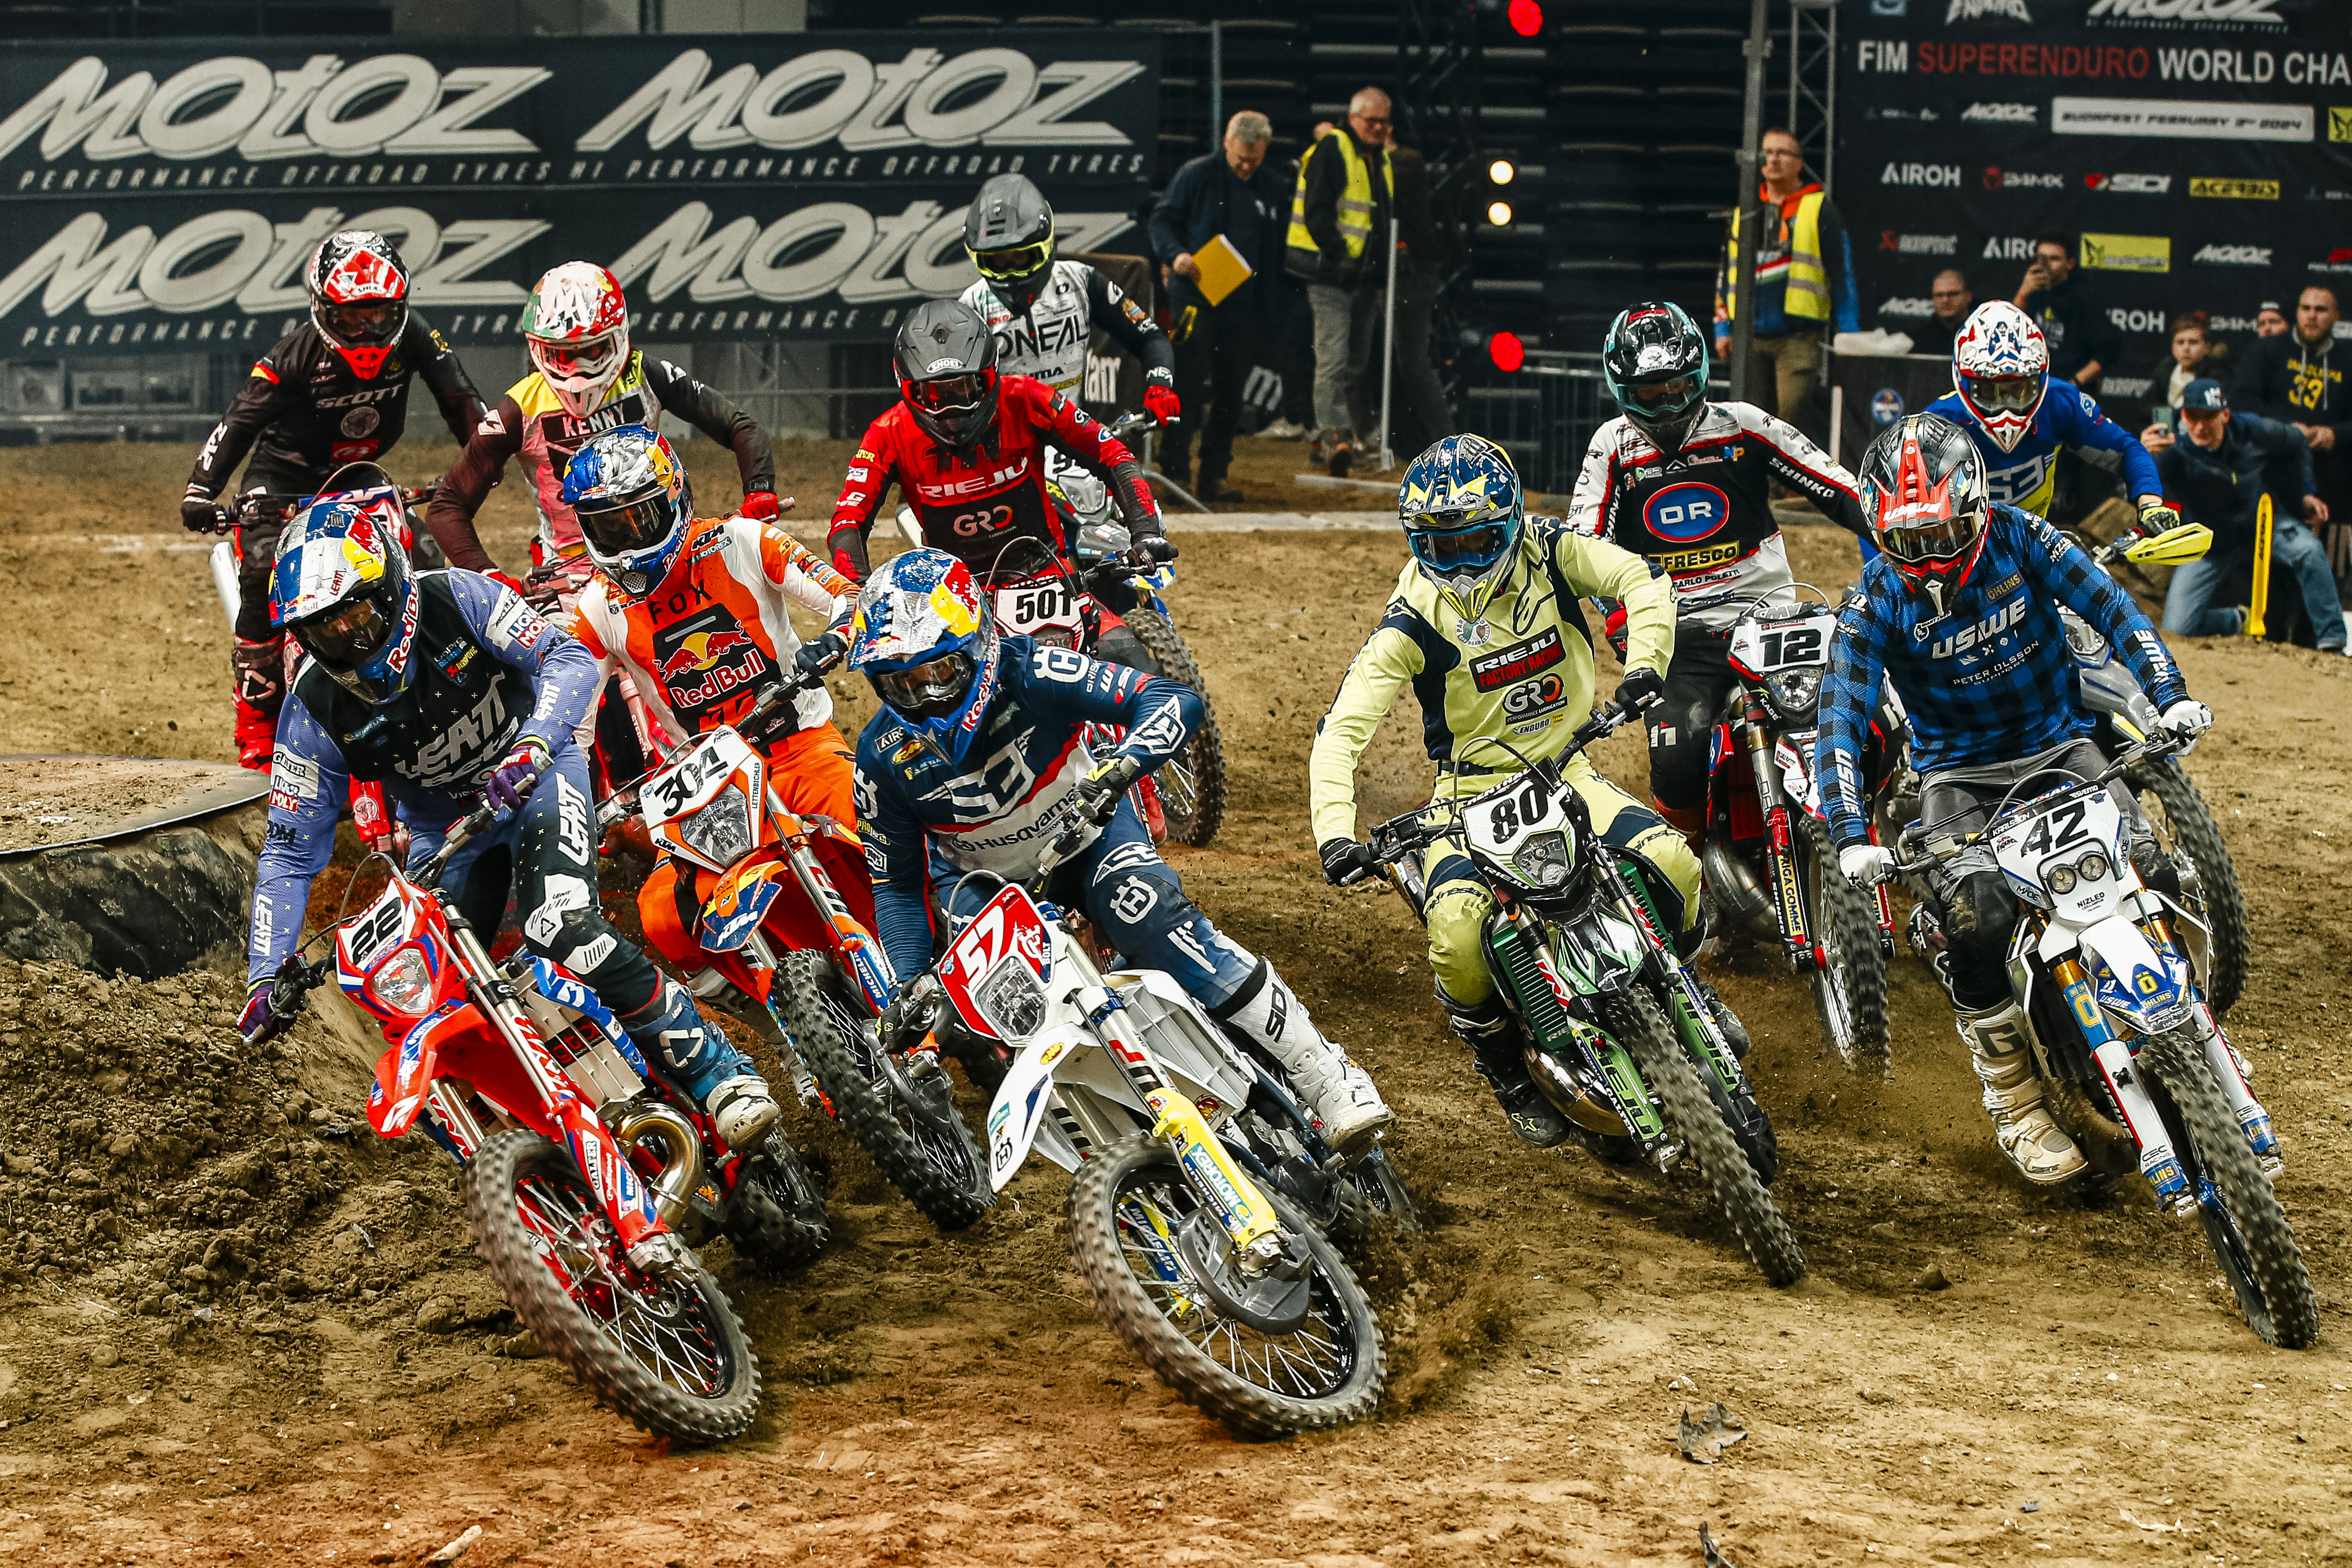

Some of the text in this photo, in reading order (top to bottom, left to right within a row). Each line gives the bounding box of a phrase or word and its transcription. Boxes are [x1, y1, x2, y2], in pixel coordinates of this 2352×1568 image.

[1858, 40, 2352, 85] FIM SUPERENDURO WORLD CHA
[0, 54, 554, 161] MOTOZ
[574, 47, 1146, 152] MOTOZ
[19, 161, 552, 190] PERFORMANCE OFFROAD TYRES
[569, 153, 1145, 180] HI PERFORMANCE OFFROAD TYRES
[1881, 161, 1962, 187] AIROH
[22, 320, 257, 346] PERFORMANCE
[450, 314, 527, 334] TYR
[633, 309, 860, 332] PERFORMANCE
[2106, 308, 2165, 333] ROH
[928, 359, 961, 372] SHOEI
[316, 383, 404, 408] SCOTT
[563, 403, 625, 438] KENNY
[1724, 445, 1745, 462] NP
[916, 456, 1028, 498] RIEJU
[1769, 457, 1835, 498] SHINKO
[1660, 500, 1712, 525] OR
[1883, 502, 1942, 522] USWE
[691, 523, 725, 551] KTM
[696, 537, 731, 562] MOTOREX
[1664, 545, 1737, 570] FRESCO
[329, 570, 344, 597] LEATT
[1672, 569, 1740, 587] CARLO POLETTI
[620, 597, 647, 610] RAM
[648, 579, 713, 626] FOX
[1016, 589, 1071, 625] 501
[386, 613, 417, 674] Red
[1931, 596, 2027, 660] USWE
[1475, 631, 1557, 674] RIEJU
[1479, 643, 1562, 687] FACTORY RACING
[1759, 629, 1822, 666] 12
[1953, 641, 2039, 686] PETER OLSSON
[2134, 629, 2169, 684] USWE
[670, 648, 766, 708] Red Bull
[1504, 676, 1561, 712] GRO
[532, 680, 562, 721] LEATT
[962, 683, 990, 732] Red
[1507, 699, 1565, 723] PERFORMANCE LUBRICATION
[880, 726, 906, 748] AIRO
[1519, 719, 1550, 734] ENDURO
[273, 752, 306, 777] GALFER
[654, 746, 729, 817] 304
[1835, 748, 1861, 817] USWE
[751, 762, 762, 809] LETTENBICHLER
[555, 772, 590, 867] LEATT
[975, 786, 1078, 851] Husqvarna
[1490, 785, 1552, 844] 80
[1992, 811, 2032, 838] KARLSSON
[2021, 801, 2090, 858] 42
[654, 838, 676, 852] KTM
[552, 890, 571, 899] LEATT
[1483, 865, 1530, 891] RIEJU
[1771, 881, 1785, 935] SHINKO
[1784, 885, 1802, 933] GOMME
[2076, 891, 2106, 908] NIZLED
[254, 893, 274, 956] LEATT
[351, 897, 402, 965] 22
[716, 910, 759, 948] KTM
[955, 905, 1005, 992] 57
[1042, 942, 1051, 965] BOLT
[1560, 963, 1589, 992] RIEJU
[1598, 968, 1629, 988] OFFROAD
[2099, 994, 2130, 1010] USWE
[1581, 1046, 1604, 1082] MICHELIN
[1605, 1087, 1636, 1136] GALFER
[586, 1141, 601, 1190] GALFER
[2141, 1146, 2169, 1163] CEC
[2144, 1151, 2171, 1170] RACING
[605, 1152, 614, 1201] Polisport
[1184, 1162, 1225, 1218] MICHELIN
[1190, 1144, 1244, 1210] MOTOREX
[1126, 1206, 1177, 1273] MICHELIN
